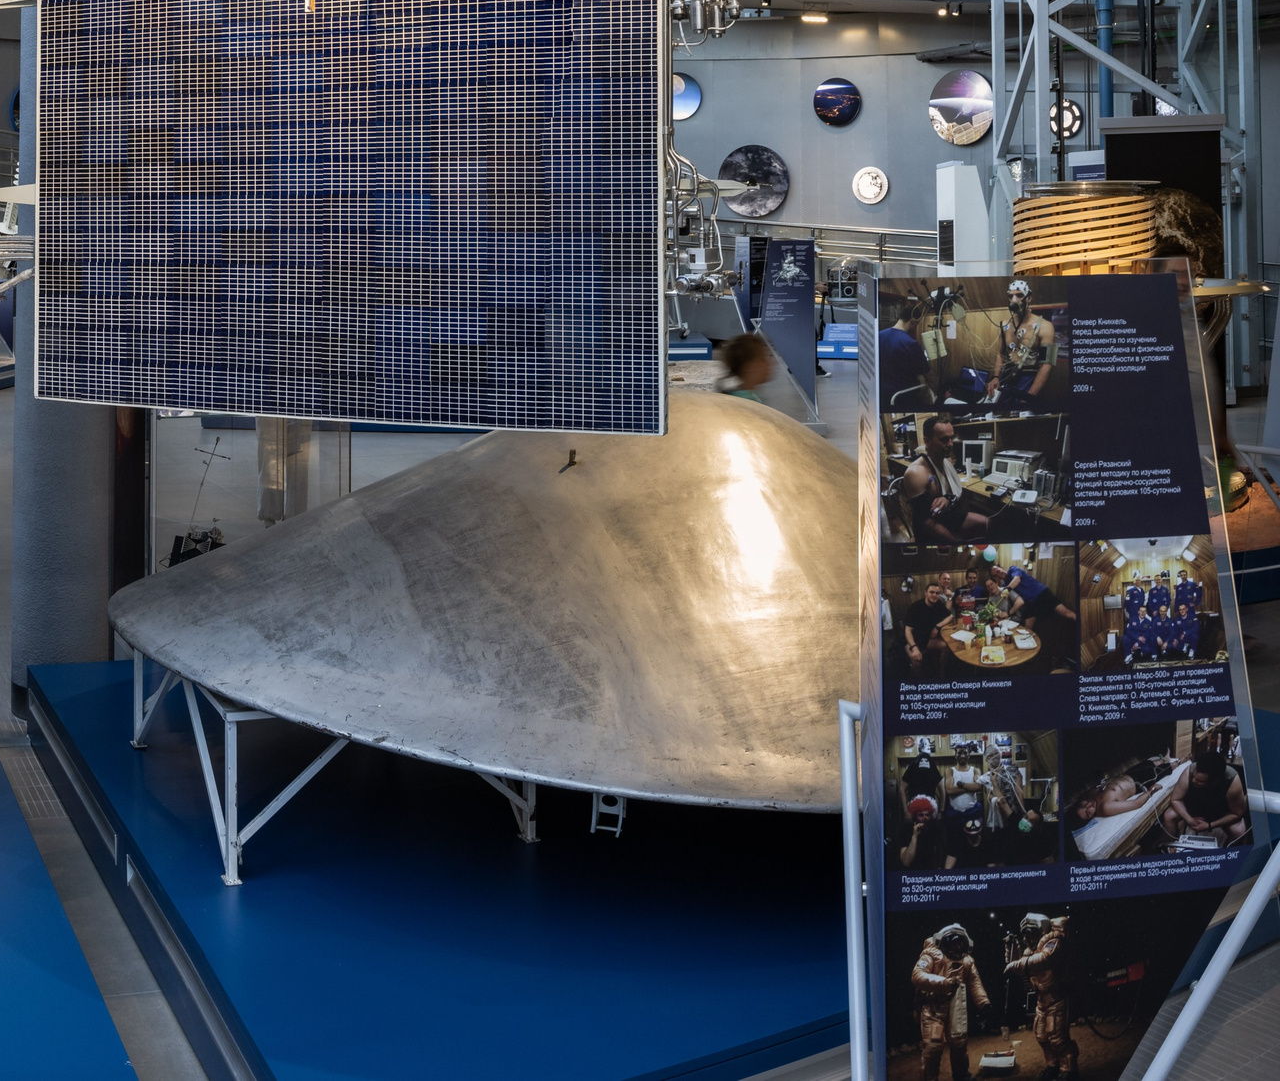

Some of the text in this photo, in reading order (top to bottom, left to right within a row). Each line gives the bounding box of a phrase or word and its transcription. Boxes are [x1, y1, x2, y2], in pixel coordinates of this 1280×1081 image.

[1072, 318, 1096, 327] Оливер
[1072, 338, 1117, 346] эксперимента
[1126, 337, 1157, 345] изучению
[1072, 346, 1130, 355] газоэнергообмена
[1136, 345, 1174, 353] физической
[1072, 355, 1134, 365] работоспособности
[1140, 355, 1170, 363] условиях
[1073, 365, 1146, 375] 105-суточной изоляции
[1073, 384, 1088, 392] 2009
[1074, 459, 1132, 470] Сергей Рязанский
[1074, 471, 1099, 480] изучает
[1100, 470, 1130, 478] методику
[1140, 468, 1171, 477] изучению
[1074, 477, 1171, 489] функций сердечно-сосудистой
[1074, 489, 1102, 498] системы
[1109, 488, 1138, 498] условиях
[1140, 486, 1181, 496] 105-суточной
[1074, 500, 1105, 508] изоляции
[1075, 518, 1091, 527] 2009
[1079, 667, 1224, 684] Экипаж проекта «Марс-500» для проведения
[900, 682, 917, 692] День
[918, 682, 951, 692] рождения
[951, 681, 981, 691] Оливера
[1079, 677, 1207, 695] эксперимента по 105-суточной изоляции
[905, 692, 922, 701] ходе
[923, 691, 969, 701] эксперимента
[1079, 694, 1100, 703] Слева
[1101, 692, 1129, 702] направо:
[1130, 691, 1138, 699] О.
[1173, 688, 1181, 696] С.
[900, 700, 986, 711] по 105-суточной изоляции
[1079, 704, 1087, 713] О.
[1120, 701, 1127, 710] А.
[1130, 699, 1159, 710] Баранов,
[1160, 698, 1168, 707] С.
[1197, 695, 1204, 704] А.
[1205, 693, 1230, 703] Шпаков
[900, 712, 925, 721] Апрель
[926, 711, 943, 720] 2009
[1079, 714, 1103, 723] Апрель
[1104, 712, 1120, 720] 2009
[1070, 865, 1096, 876] Первый
[1097, 861, 1141, 873] ежемесячный
[1186, 853, 1226, 865] Регистрация
[1227, 850, 1240, 860] ЭКГ
[901, 869, 1046, 885] Праздник Хэллоуин во время эксперимента
[1076, 874, 1091, 884] ходе
[1092, 870, 1137, 882] эксперимента
[1138, 870, 1147, 878] по
[1147, 865, 1190, 877] 520-суточной
[1190, 862, 1220, 873] изоляции
[911, 883, 955, 894] 520-суточной
[956, 882, 988, 892] изоляции
[1070, 882, 1103, 892] 2010-2011
[901, 893, 935, 903] 2010-2011
